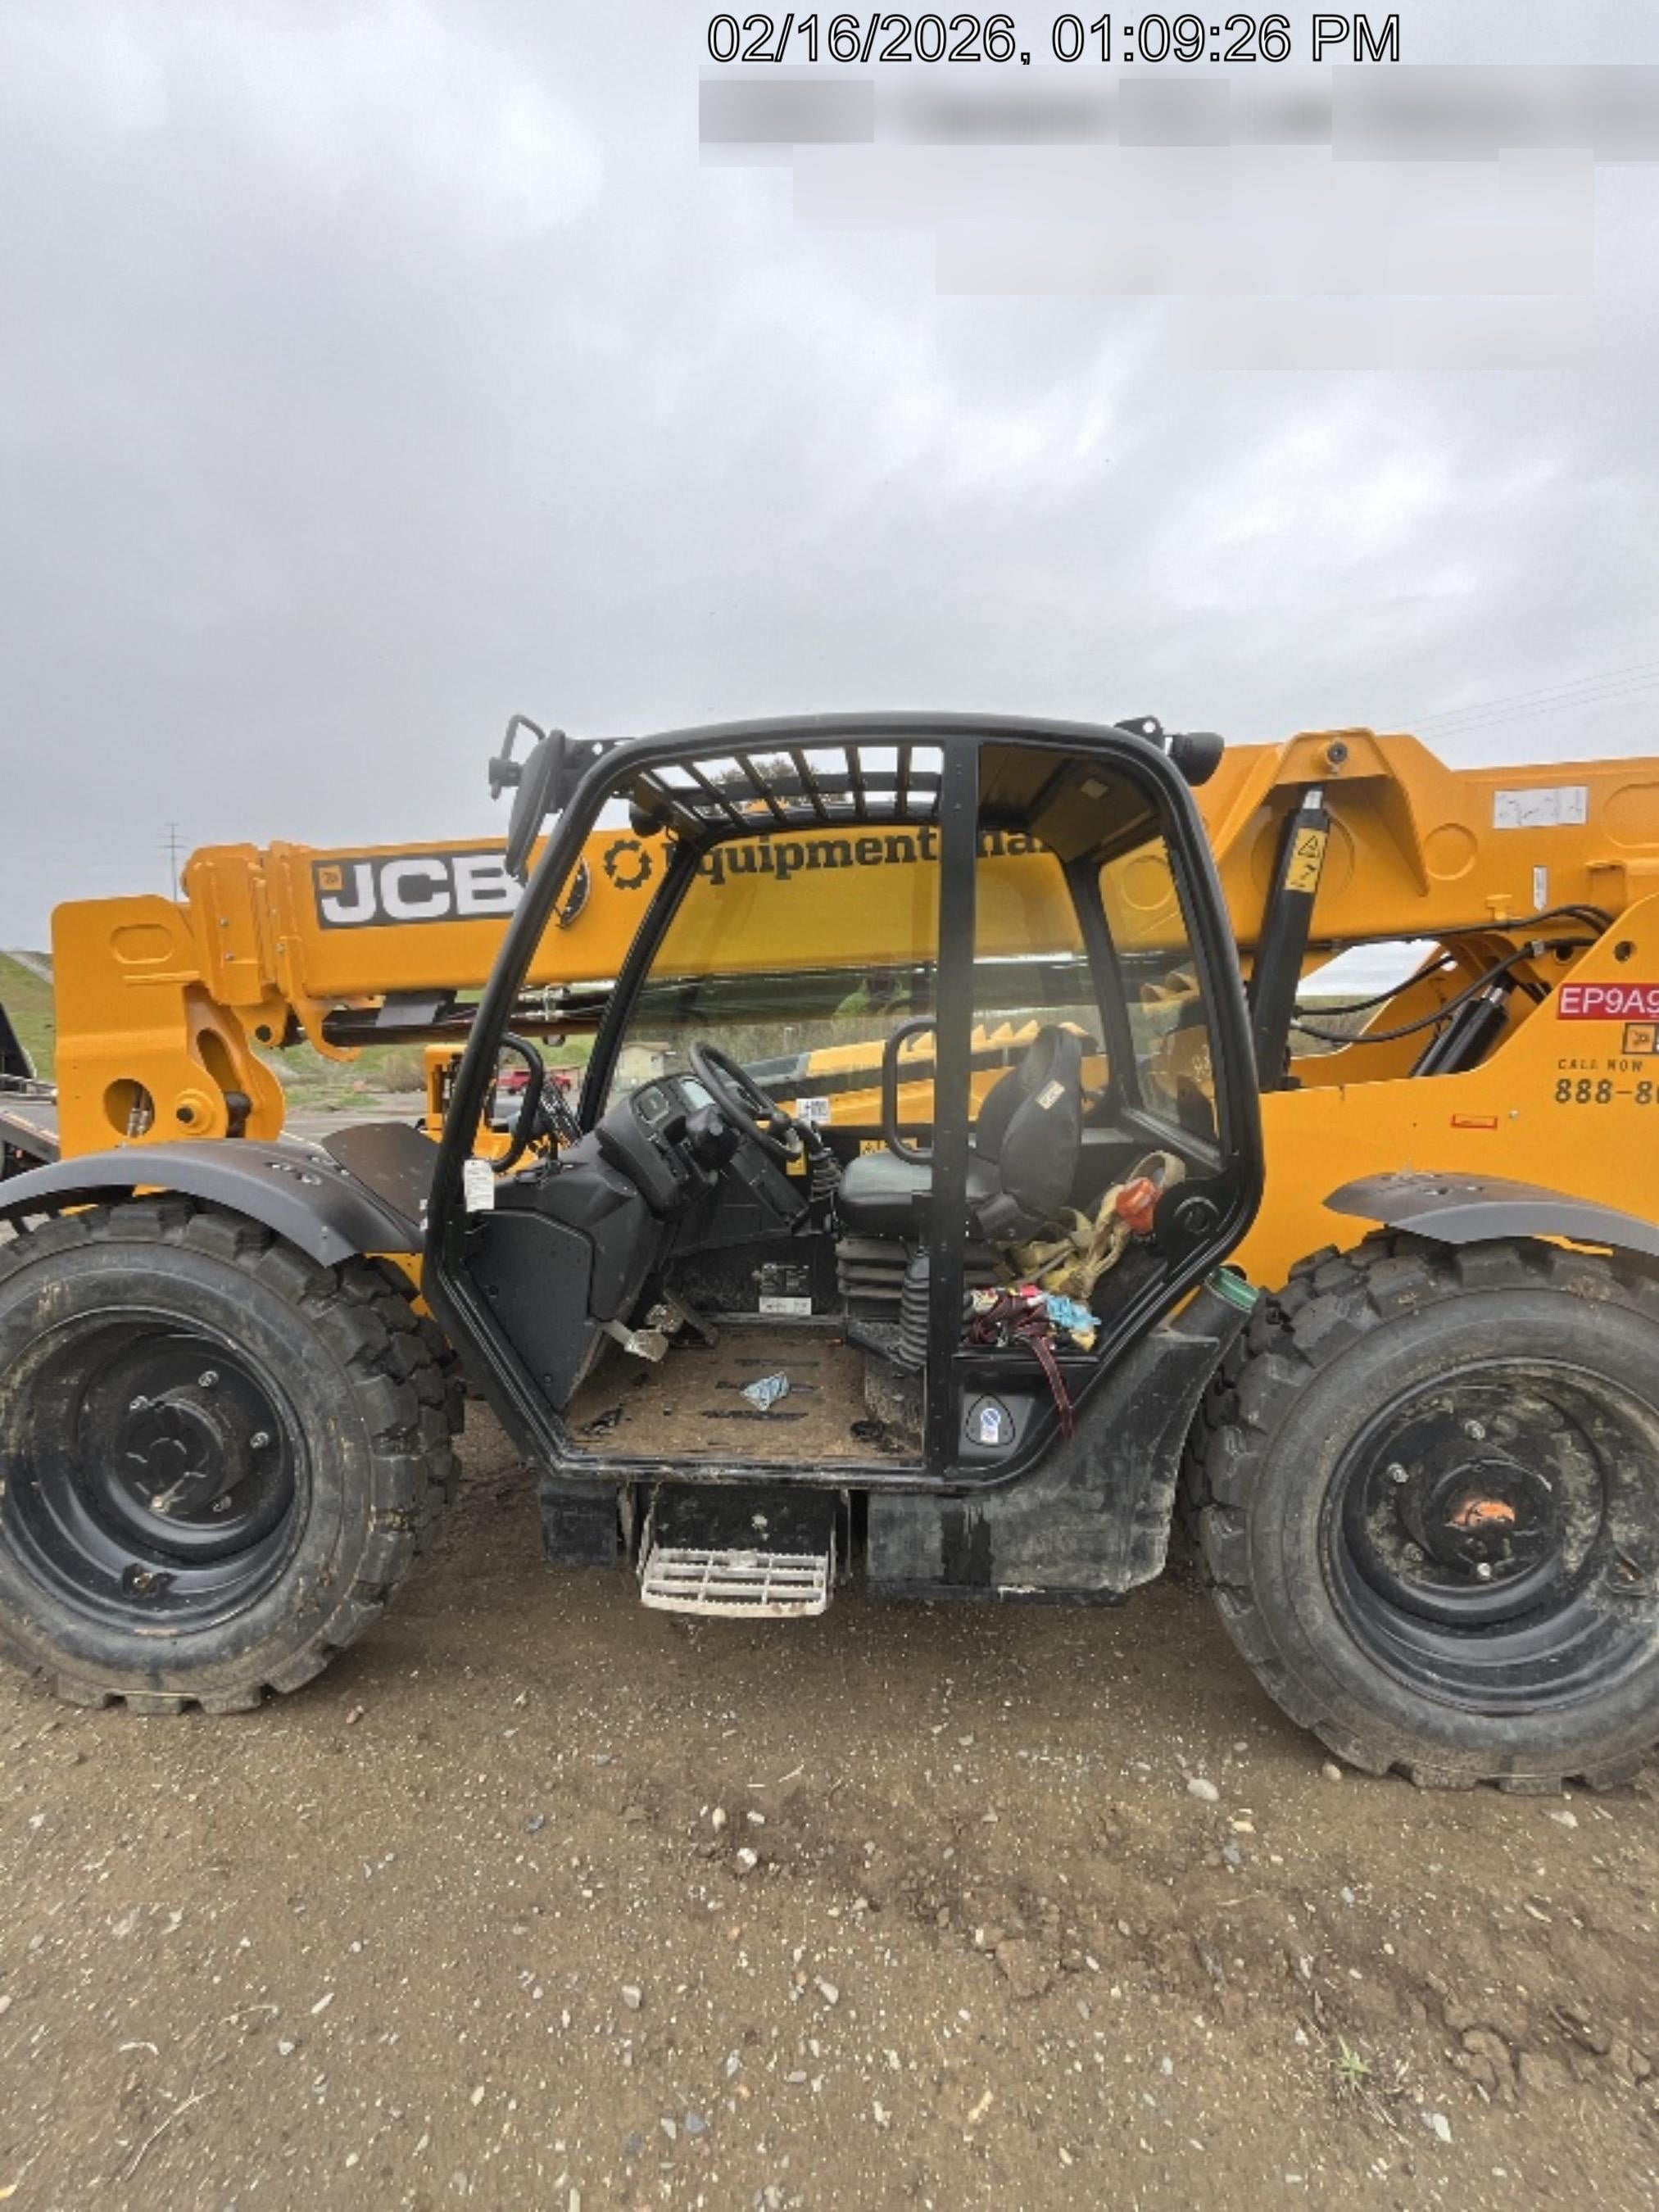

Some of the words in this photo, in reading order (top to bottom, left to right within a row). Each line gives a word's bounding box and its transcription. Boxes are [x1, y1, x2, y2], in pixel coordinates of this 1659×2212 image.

[321, 854, 526, 922] JCB
[1558, 1059, 1597, 1070] CALL
[1607, 1058, 1643, 1072] NOW
[1555, 1078, 1659, 1104] 888-8
